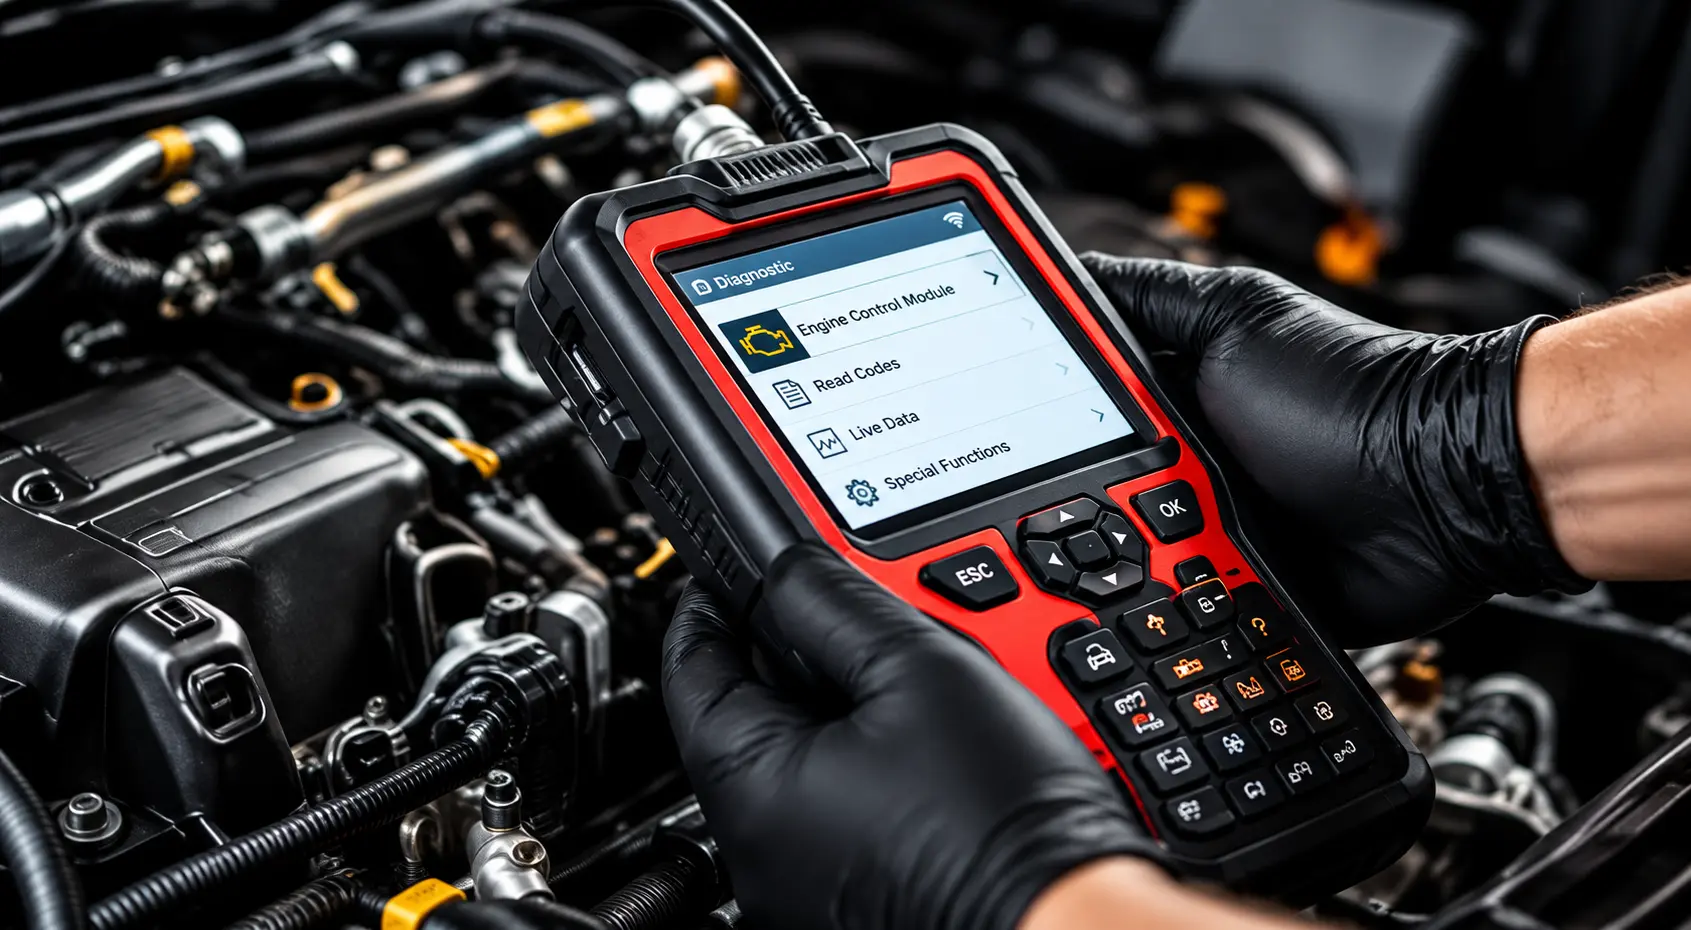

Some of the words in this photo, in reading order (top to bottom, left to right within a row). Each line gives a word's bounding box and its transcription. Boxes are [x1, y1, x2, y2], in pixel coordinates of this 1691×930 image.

[713, 260, 795, 290] Diagnostic
[797, 314, 848, 337] Engine
[849, 298, 902, 322] Control
[902, 284, 956, 307] Module
[813, 370, 854, 393] Read
[854, 358, 901, 380] Codes
[849, 424, 883, 441] Live
[882, 412, 920, 430] Data
[884, 463, 940, 490] Special
[938, 442, 1011, 472] Functions
[1159, 498, 1187, 519] OK
[955, 562, 994, 587] ESC
